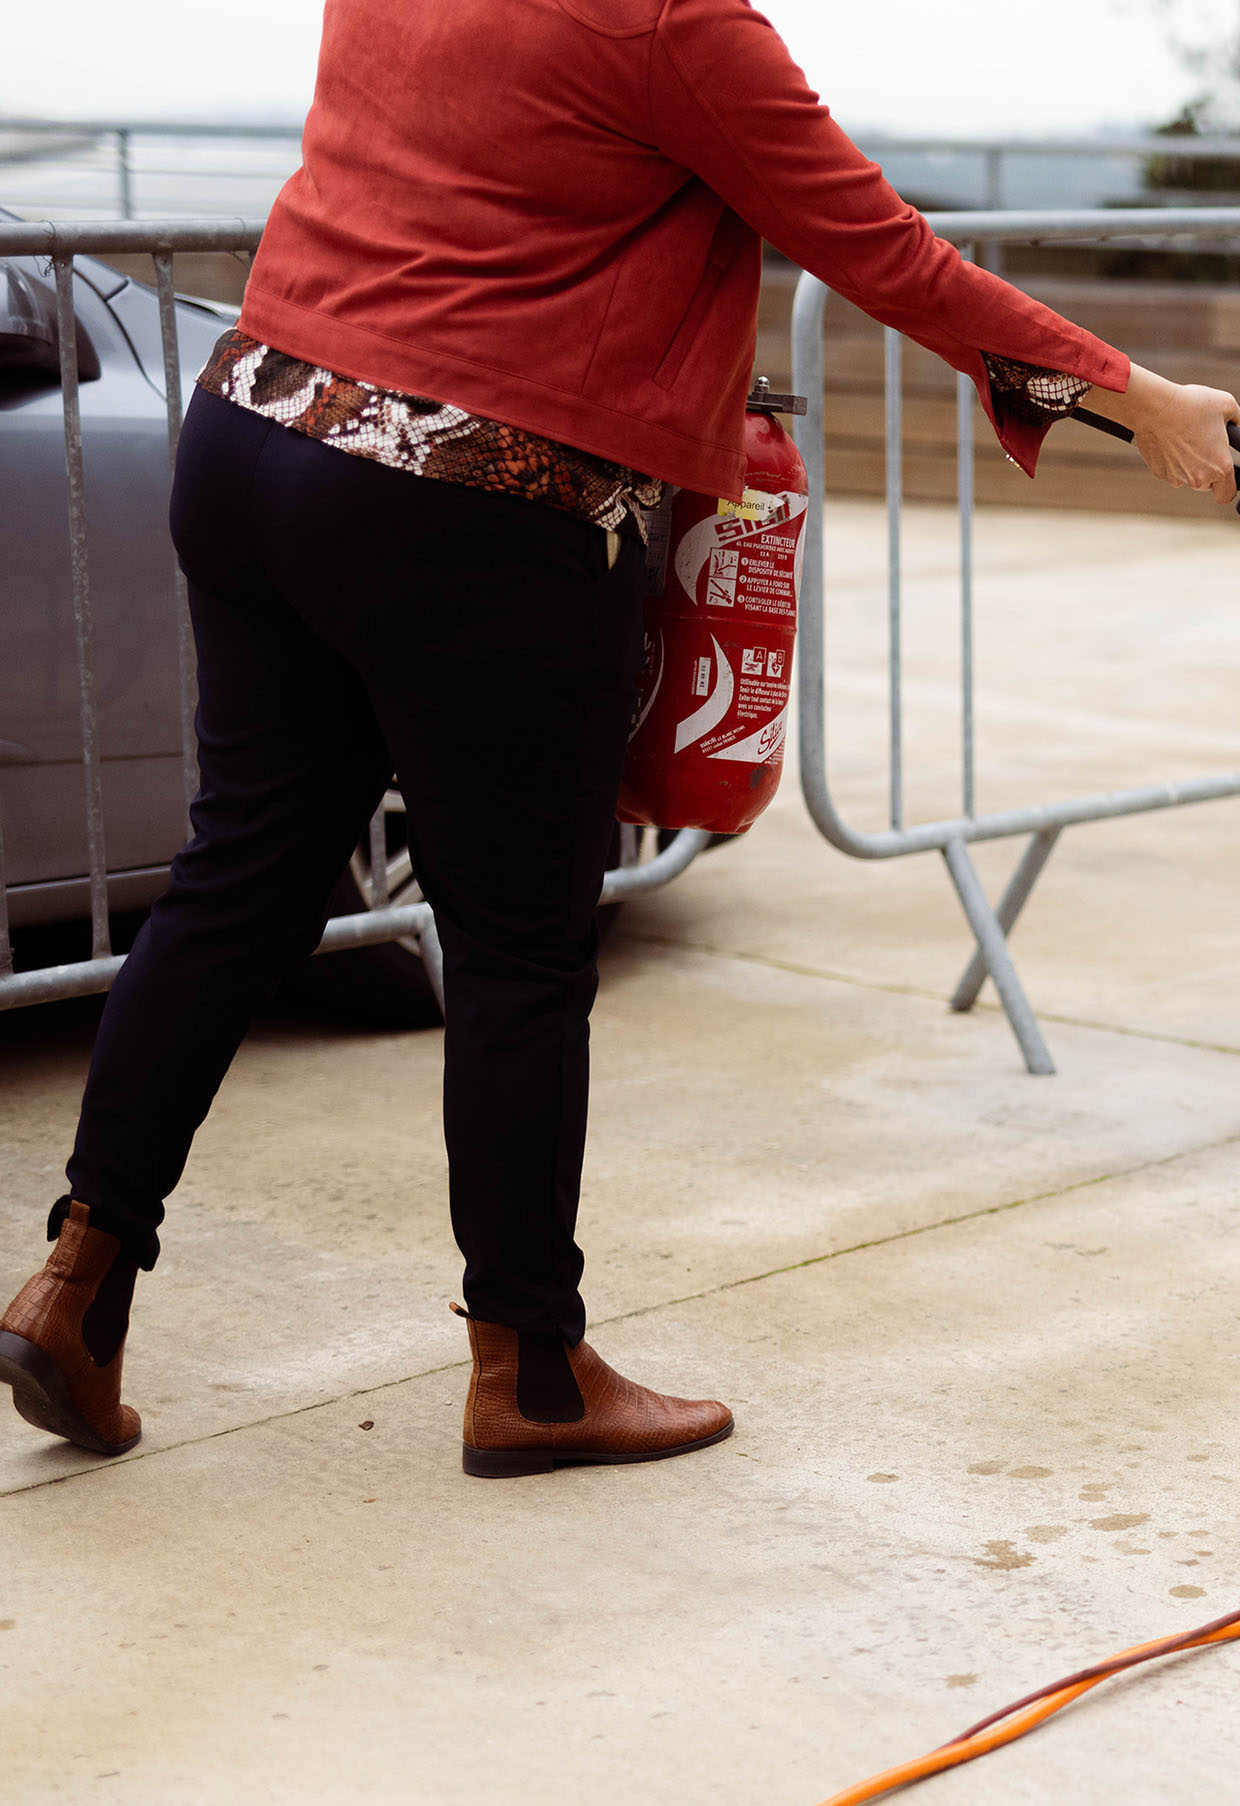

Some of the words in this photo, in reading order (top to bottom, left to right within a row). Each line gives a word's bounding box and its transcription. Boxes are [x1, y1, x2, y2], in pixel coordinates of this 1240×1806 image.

[761, 534, 796, 548] EXTINCTEUR
[749, 559, 769, 568] ENLEVER
[769, 561, 775, 569] LE
[748, 567, 772, 576] DISPOSITIF
[747, 577, 768, 586] APPUYER
[753, 585, 769, 593] LEVIER
[745, 596, 772, 605] CONTROLER
[744, 603, 762, 611] VISANT
[768, 606, 779, 614] BASE
[740, 678, 760, 686] Utilisable
